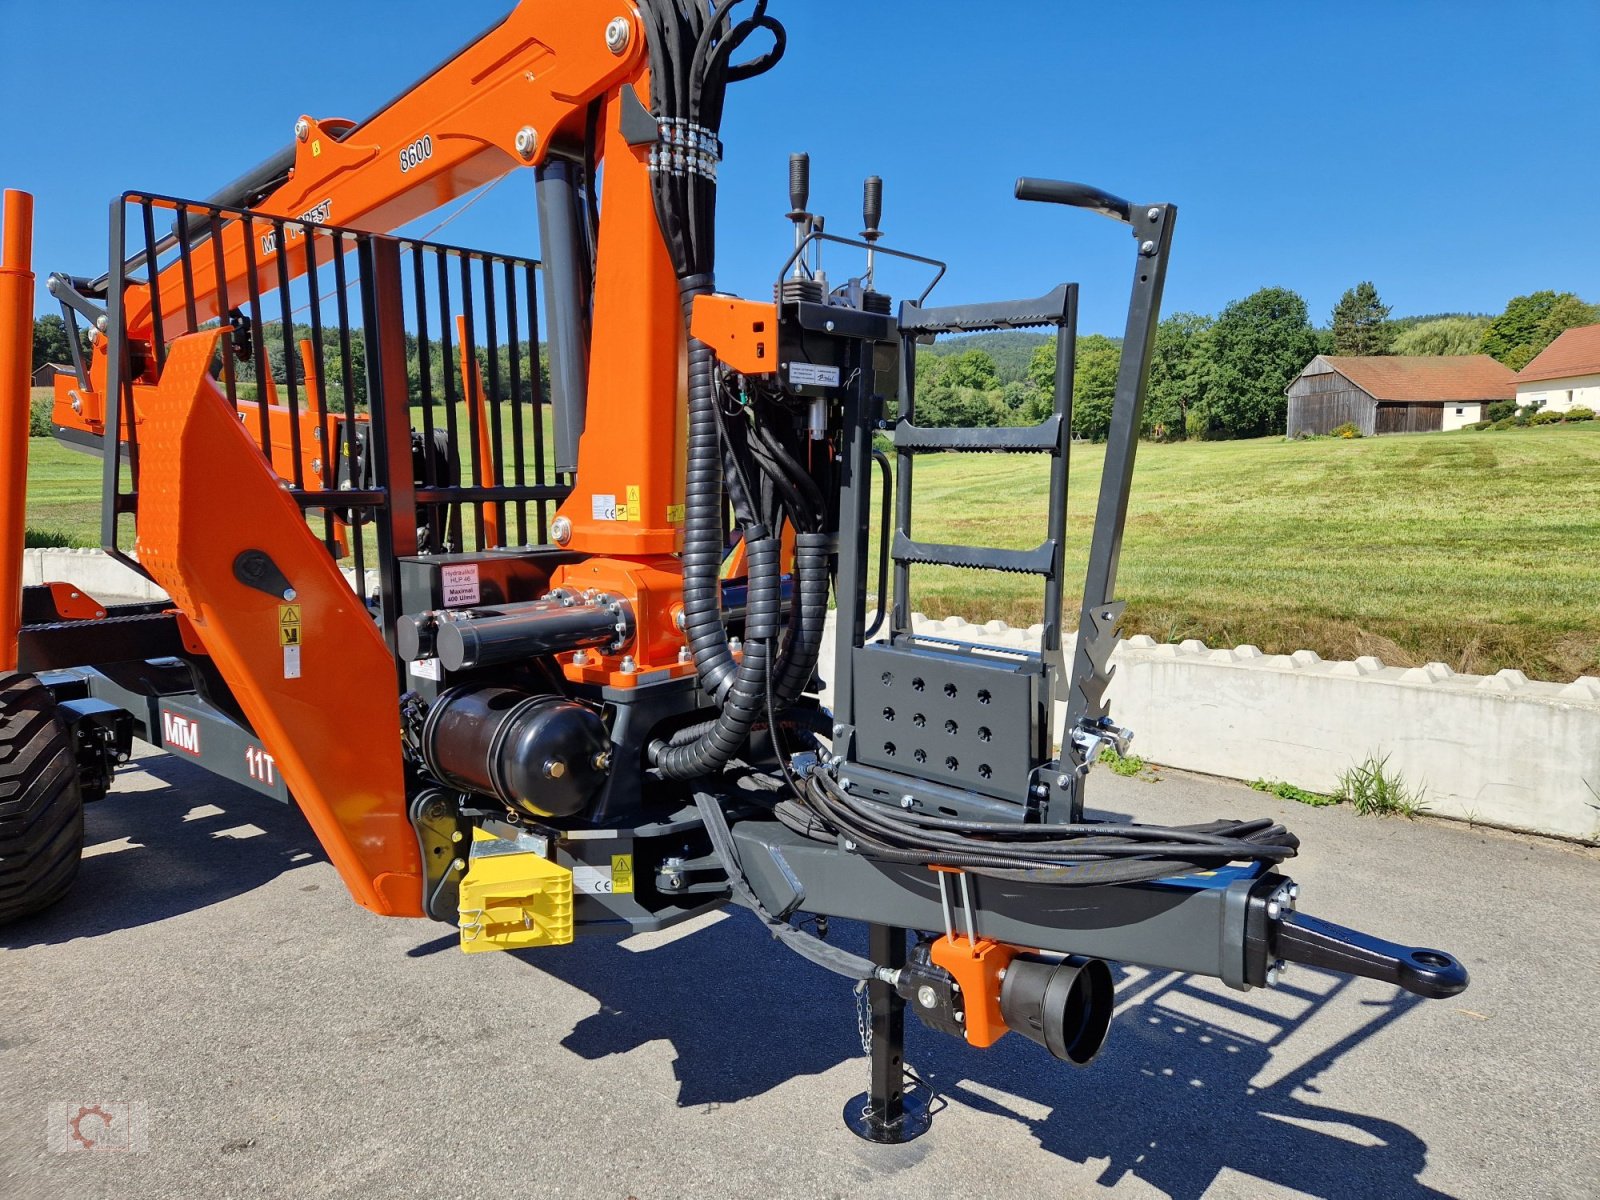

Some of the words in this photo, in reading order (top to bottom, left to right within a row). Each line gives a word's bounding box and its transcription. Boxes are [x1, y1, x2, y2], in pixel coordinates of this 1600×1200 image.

[400, 133, 432, 173] 8600
[162, 710, 200, 757] MTM
[245, 745, 275, 786] 11T
